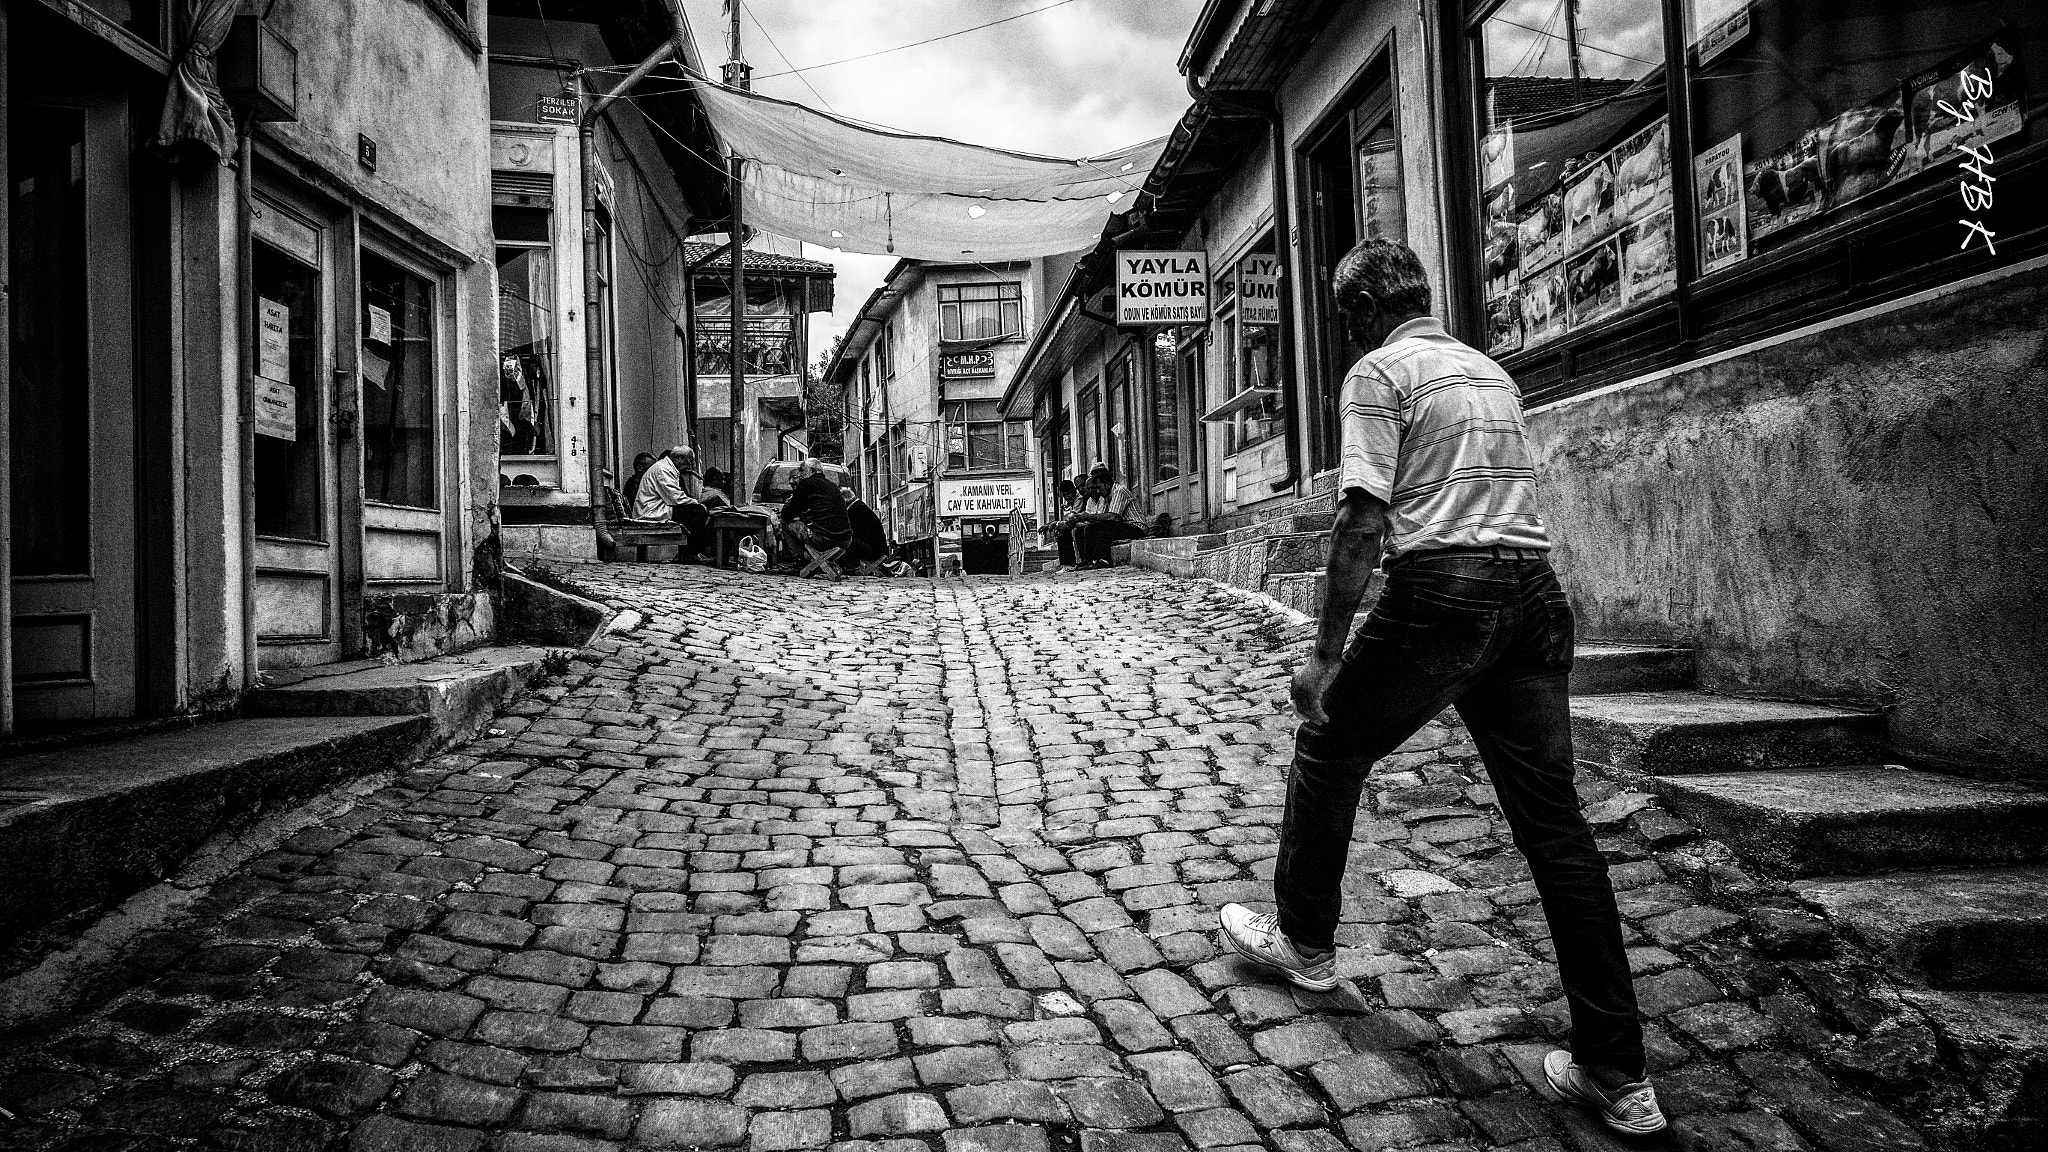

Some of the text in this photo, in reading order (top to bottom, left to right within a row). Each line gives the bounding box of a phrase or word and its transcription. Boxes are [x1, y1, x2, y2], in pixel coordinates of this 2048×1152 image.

[542, 105, 575, 116] SOKAK
[365, 145, 370, 157] 5
[1705, 147, 1730, 166] PAPAYOU
[1754, 157, 1770, 171] 2011
[1125, 258, 1201, 275] YAYLA
[1121, 278, 1206, 298] KÖMÜR
[266, 307, 281, 319] ASAT
[1123, 307, 1140, 321] ODUN
[1141, 307, 1149, 320] VE
[1151, 304, 1172, 320] KÖMÜR
[964, 499, 974, 511] VE
[976, 498, 1012, 510] KAHVALTI
